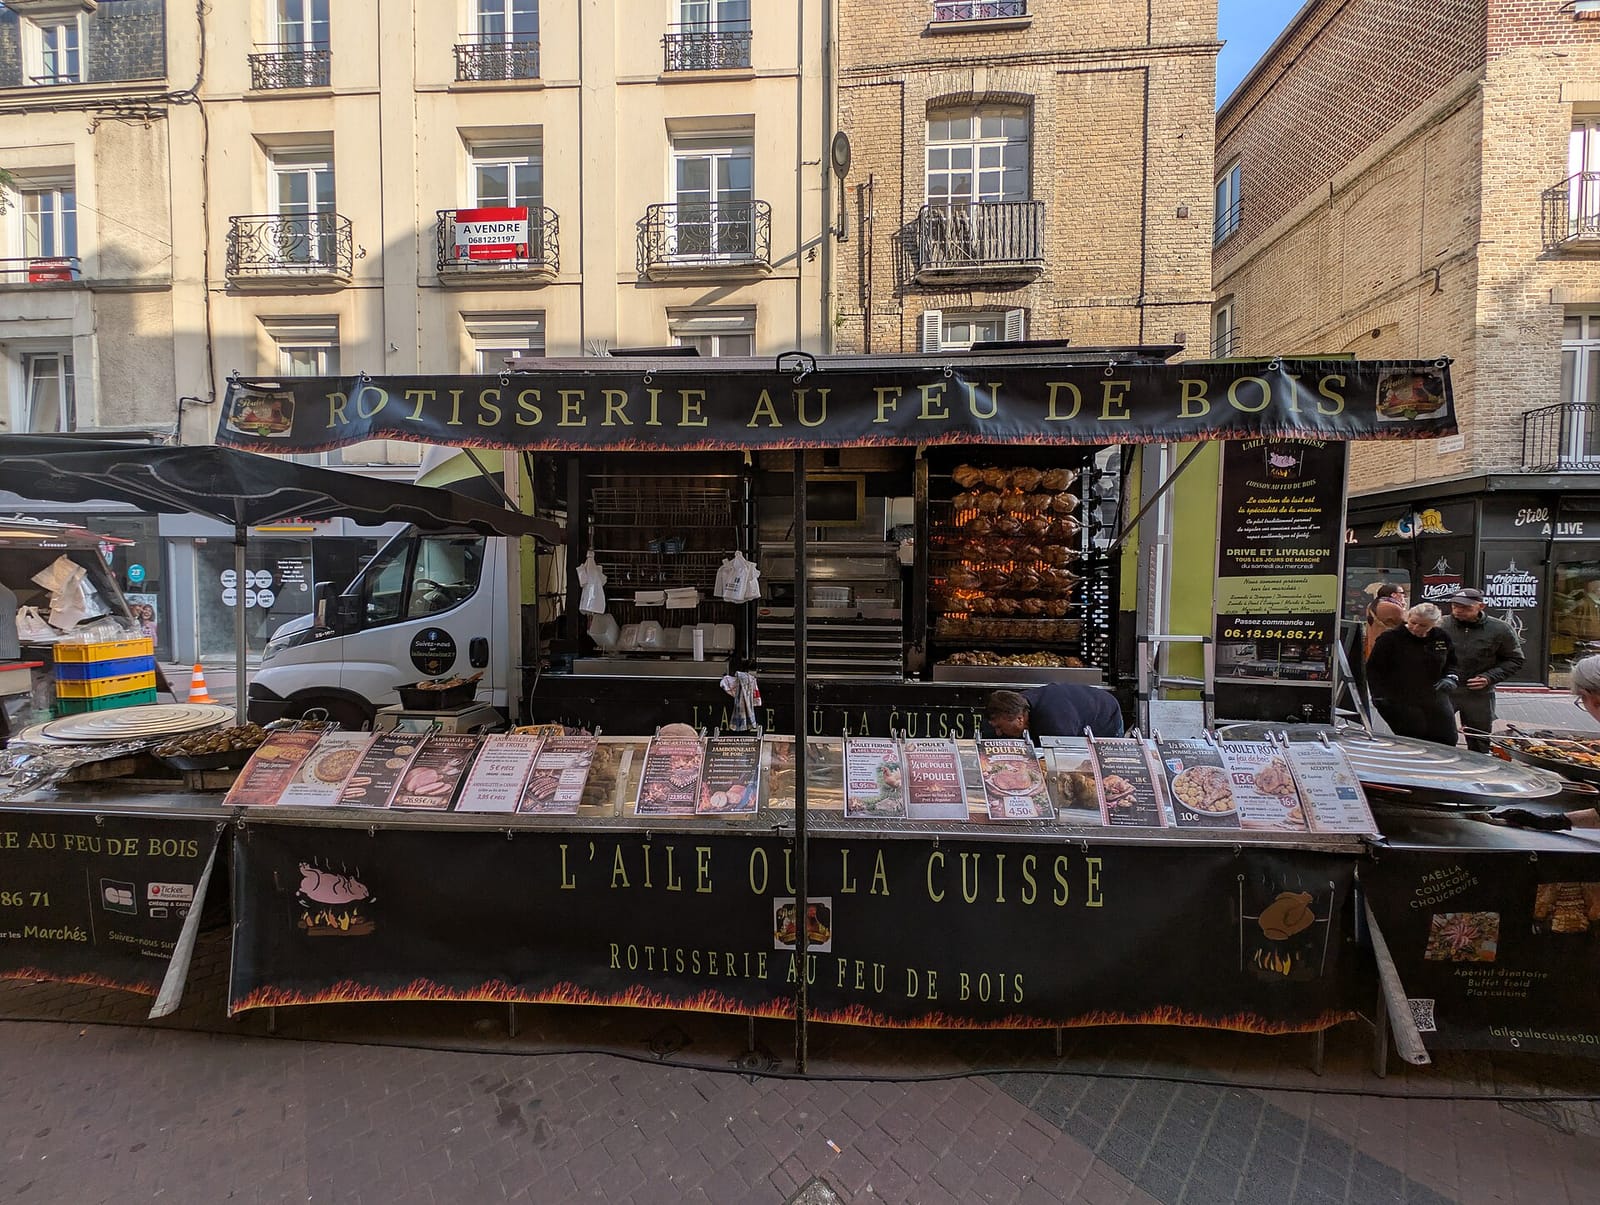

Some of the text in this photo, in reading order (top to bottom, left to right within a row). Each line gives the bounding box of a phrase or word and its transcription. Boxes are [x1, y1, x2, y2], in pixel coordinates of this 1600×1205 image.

[463, 223, 520, 234] A VENDRE
[468, 236, 515, 244] 0681221197
[326, 374, 1347, 428] ROTISSERIE AU FEU DE BOIS
[1515, 507, 1549, 526] Still
[1227, 548, 1256, 556] DRIVE
[1276, 548, 1330, 556] LIVRAISON
[1486, 584, 1536, 596] MODERN
[1482, 597, 1538, 607] PINSTRIPING
[1224, 629, 1324, 640] 06.18.94.86.71
[692, 706, 775, 733] L'AE
[985, 747, 1027, 755] POULET
[1223, 744, 1256, 754] POULET
[923, 773, 956, 781] POULET
[1233, 773, 1254, 784] 13€
[1281, 798, 1296, 806] 16€
[1180, 812, 1200, 821] 10€
[27, 832, 56, 849] AU
[64, 834, 101, 853] FEU
[106, 838, 139, 856] DE
[148, 838, 199, 858] BOIS
[559, 843, 713, 896] L'AILE
[840, 848, 891, 897] LA
[927, 850, 1105, 908] CUISSE
[1415, 870, 1470, 896] COUSCOUS
[160, 885, 184, 894] Ticket
[1409, 876, 1479, 909] CHOUCROUTE
[1, 892, 50, 907] 86 71
[9, 926, 88, 942] les Marchés
[109, 931, 175, 950] Suivez-nous sur
[609, 942, 1025, 1004] ROTISSERIE AU FEU DE BOIS
[1468, 978, 1530, 988] Buffet froid
[1466, 988, 1487, 997] Plat
